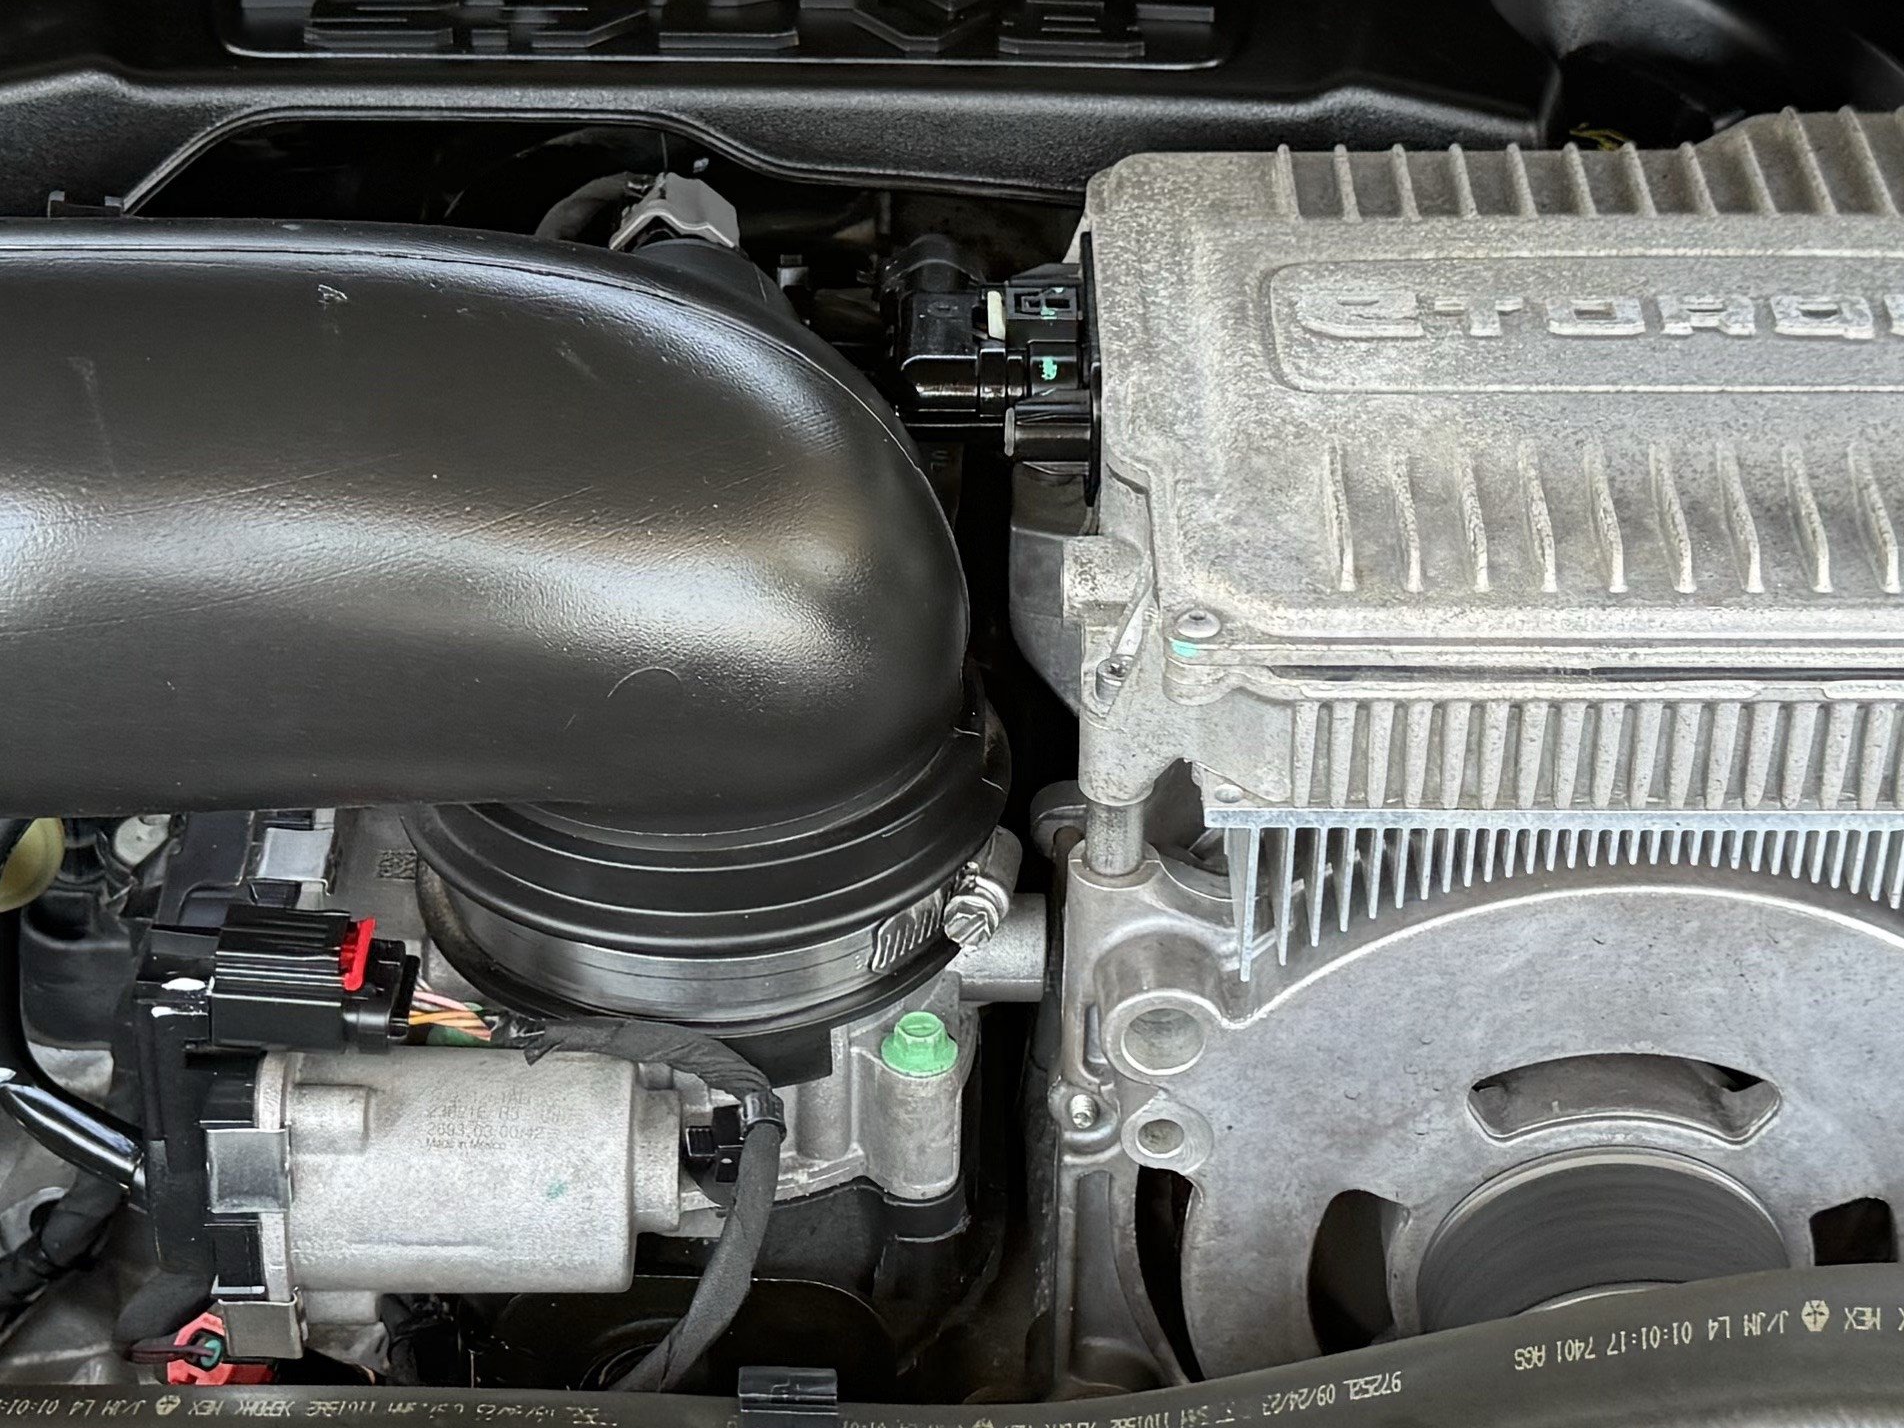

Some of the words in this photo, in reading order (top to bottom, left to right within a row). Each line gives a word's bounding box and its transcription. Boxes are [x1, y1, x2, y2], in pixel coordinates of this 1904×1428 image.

[1707, 1316, 1731, 1341] L4
[1742, 1310, 1790, 1335] J/JM
[1843, 1307, 1882, 1331] MEX
[1555, 1335, 1597, 1362] 7401
[1605, 1321, 1693, 1354] 01:01:17
[1513, 1343, 1547, 1371] AGS
[67, 1399, 96, 1417] L4
